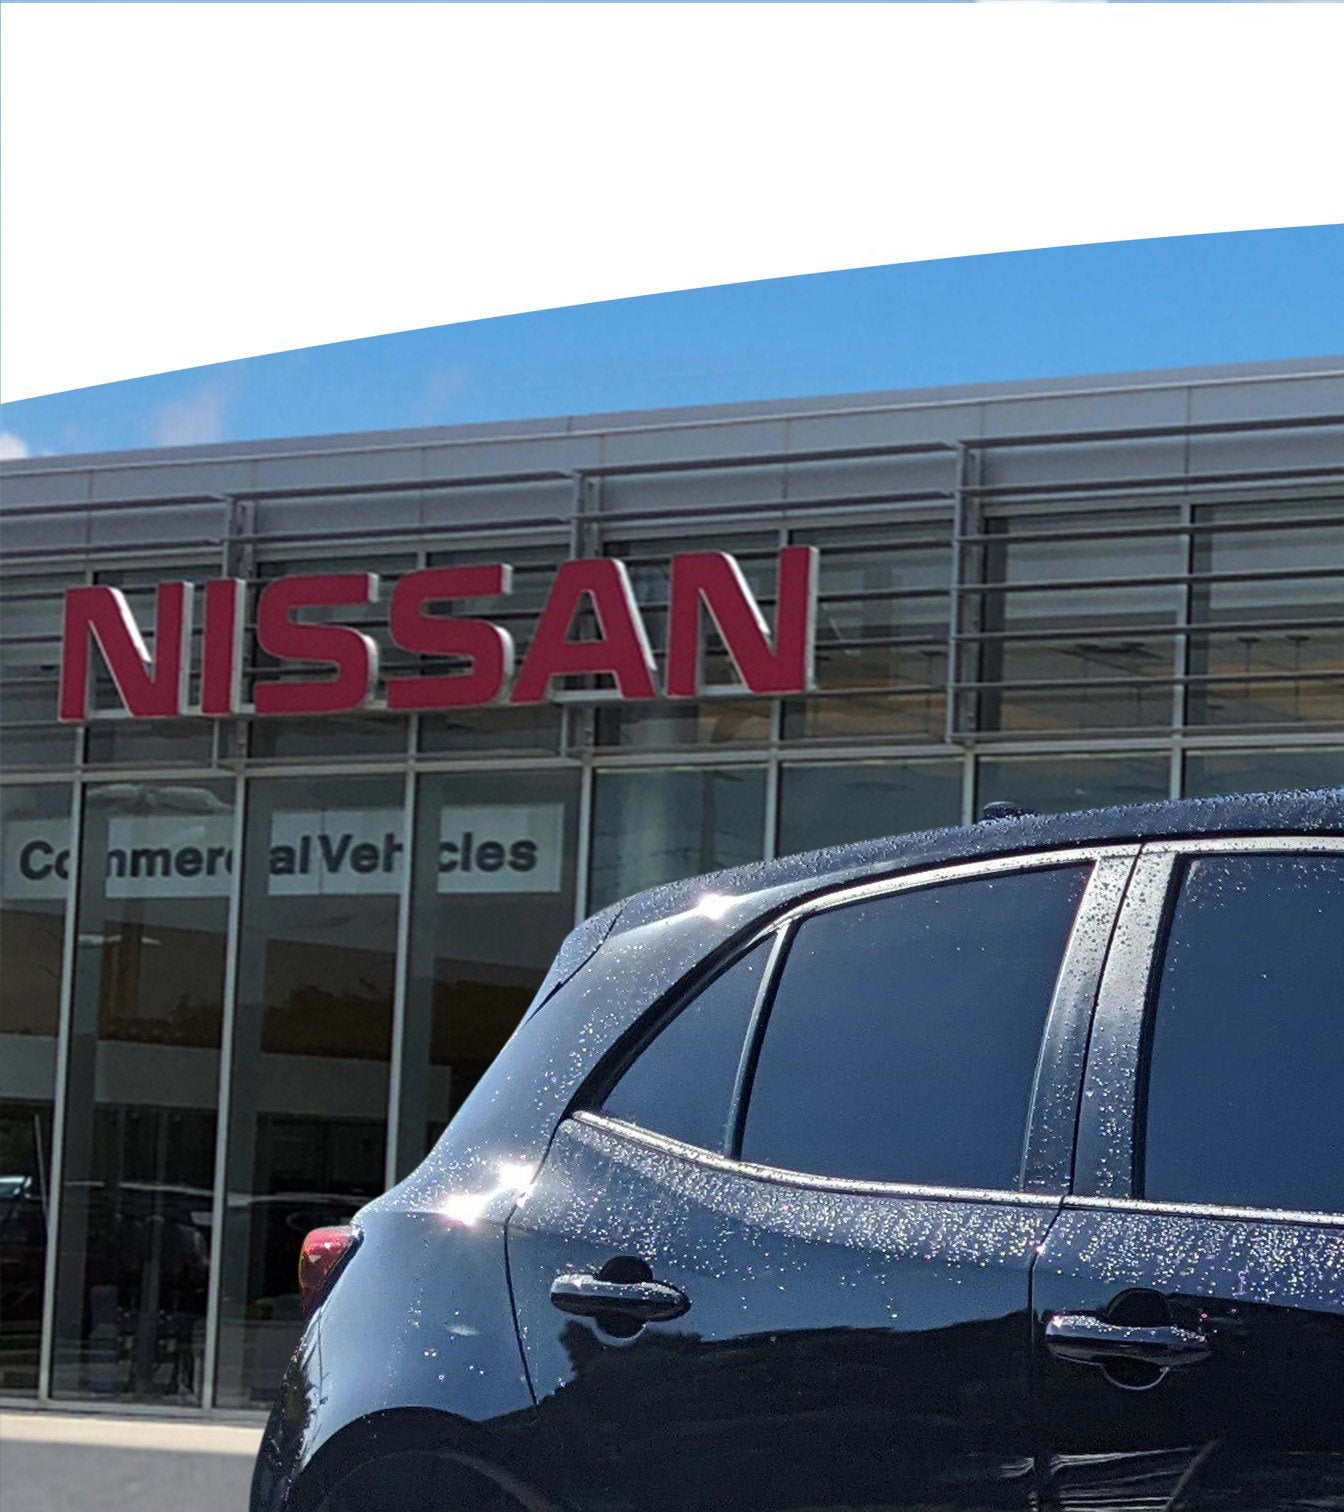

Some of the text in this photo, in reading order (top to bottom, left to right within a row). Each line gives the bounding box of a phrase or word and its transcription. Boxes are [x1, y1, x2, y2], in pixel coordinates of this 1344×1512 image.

[57, 546, 818, 722] NISSAN
[19, 832, 538, 880] Commeral Vehcles
